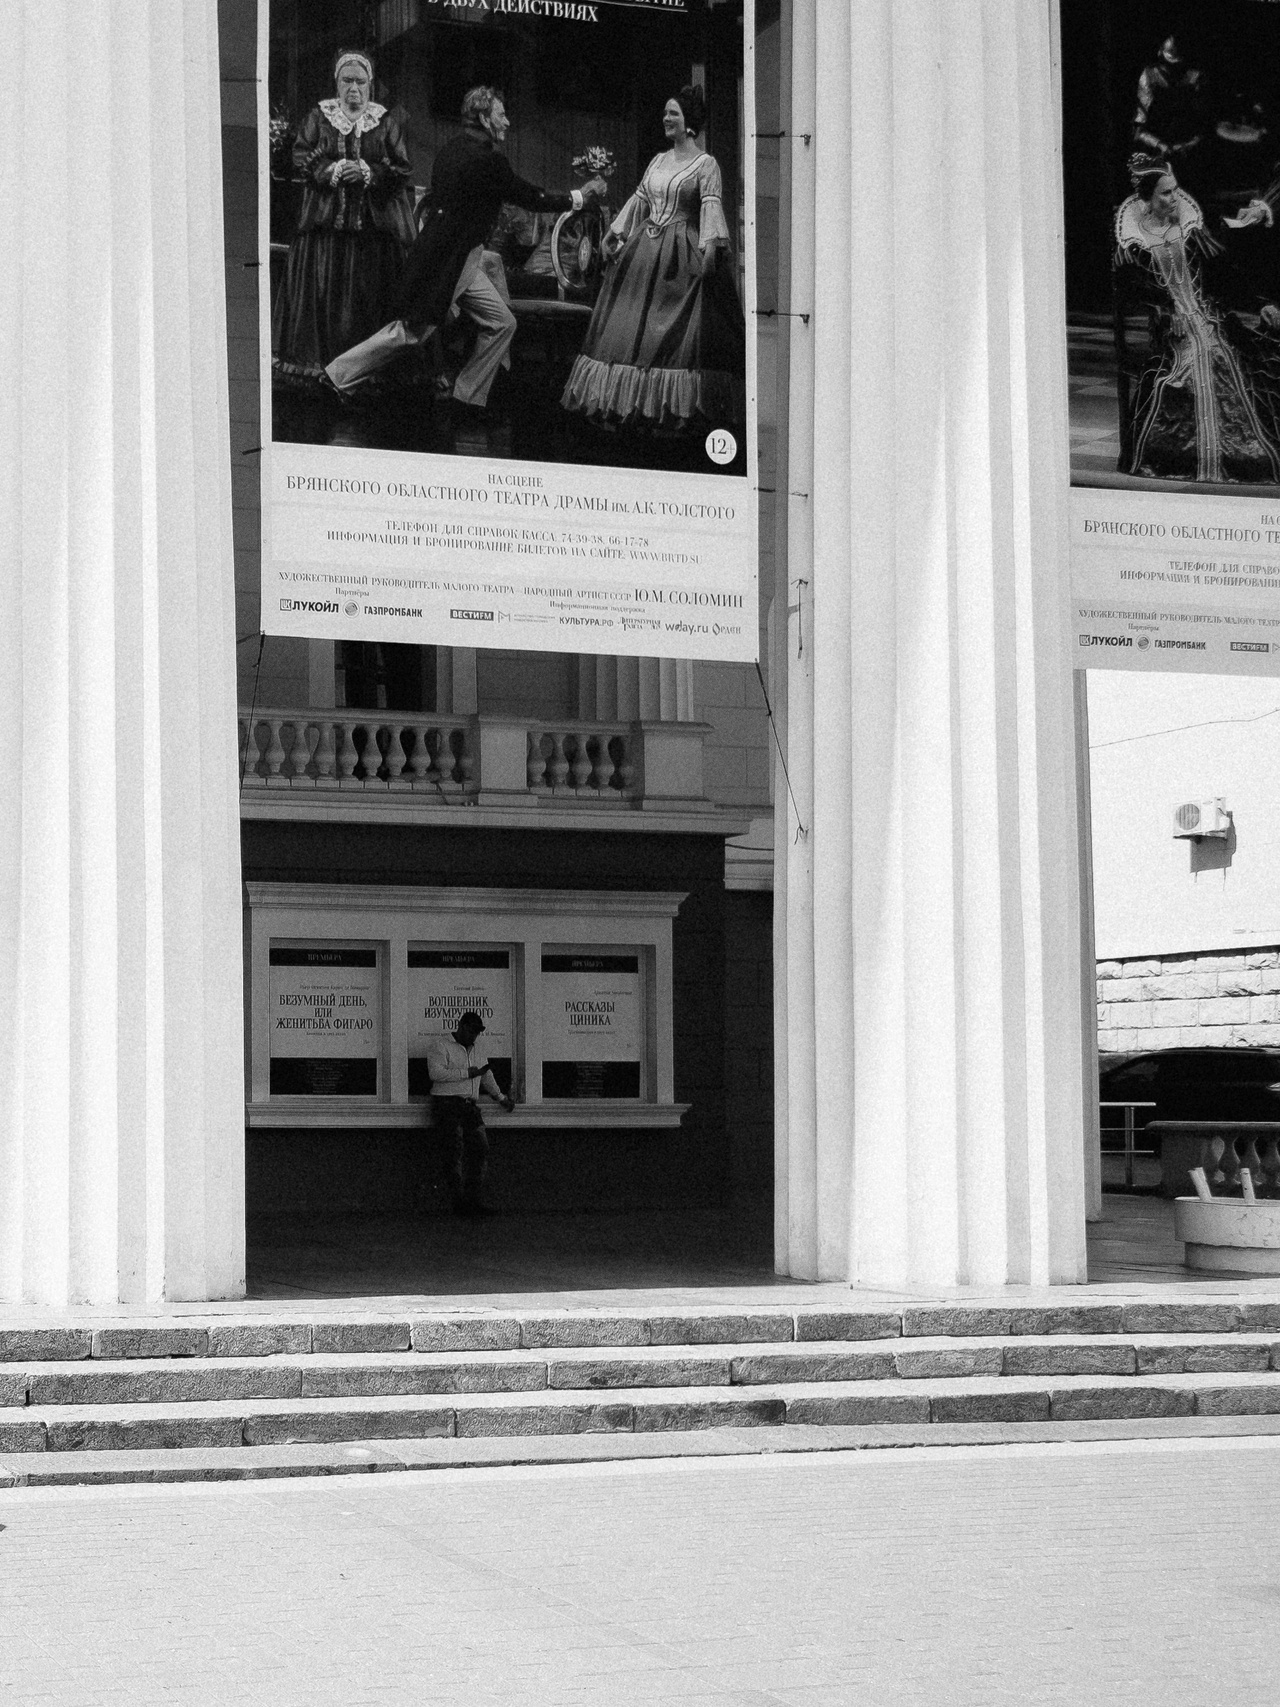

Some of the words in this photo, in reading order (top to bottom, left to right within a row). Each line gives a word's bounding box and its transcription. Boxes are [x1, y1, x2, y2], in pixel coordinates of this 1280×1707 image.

[709, 437, 736, 455] 12+
[487, 474, 502, 485] НА
[505, 475, 544, 488] СЦЕНЕ
[286, 475, 381, 495] БРЯНСКОГО
[387, 483, 488, 503] ОБЛАСТНОГО
[494, 489, 549, 507] ТЕАТРА
[554, 495, 608, 512] ДРАМЫ
[611, 501, 630, 513] им.
[659, 502, 735, 520] ТОЛСТОГО
[385, 520, 438, 533] ТЕЛЕФОН
[441, 524, 464, 536] ДЛЯ
[1083, 519, 1166, 537] БРЯНСКОГО
[1171, 525, 1260, 543] ОБЛАСТНОГО
[327, 530, 408, 546] ИНФОРМАЦИЯ
[425, 537, 514, 553] БРОНИРОВАНИЕ
[517, 542, 567, 556] БИЛЕТОВ
[279, 571, 368, 586] ХУДОЖЕСТВЕННЫЙ
[634, 588, 666, 604] Ю.М.
[669, 590, 743, 608] СОЛОМИН
[292, 600, 339, 613] ЛУКОЙЛ
[364, 605, 423, 618] ГАЗПРОМБАНК
[1091, 635, 1133, 647] ЛУКОЙЛ
[1154, 638, 1206, 650] ГАЗПРОМБАНК
[279, 993, 336, 1007] БЕЗУМНЫЙ
[338, 995, 368, 1008] ДЕНЬ,
[429, 996, 489, 1008] ВОЛШЕБНИК
[565, 1001, 615, 1013] РАССКАЗЫ
[314, 1008, 332, 1018] ИЛИ
[276, 1017, 331, 1030] ЖЕНИТЬБА
[333, 1018, 373, 1030] ФИГАРО
[570, 1014, 611, 1027] ЦИНИКА
